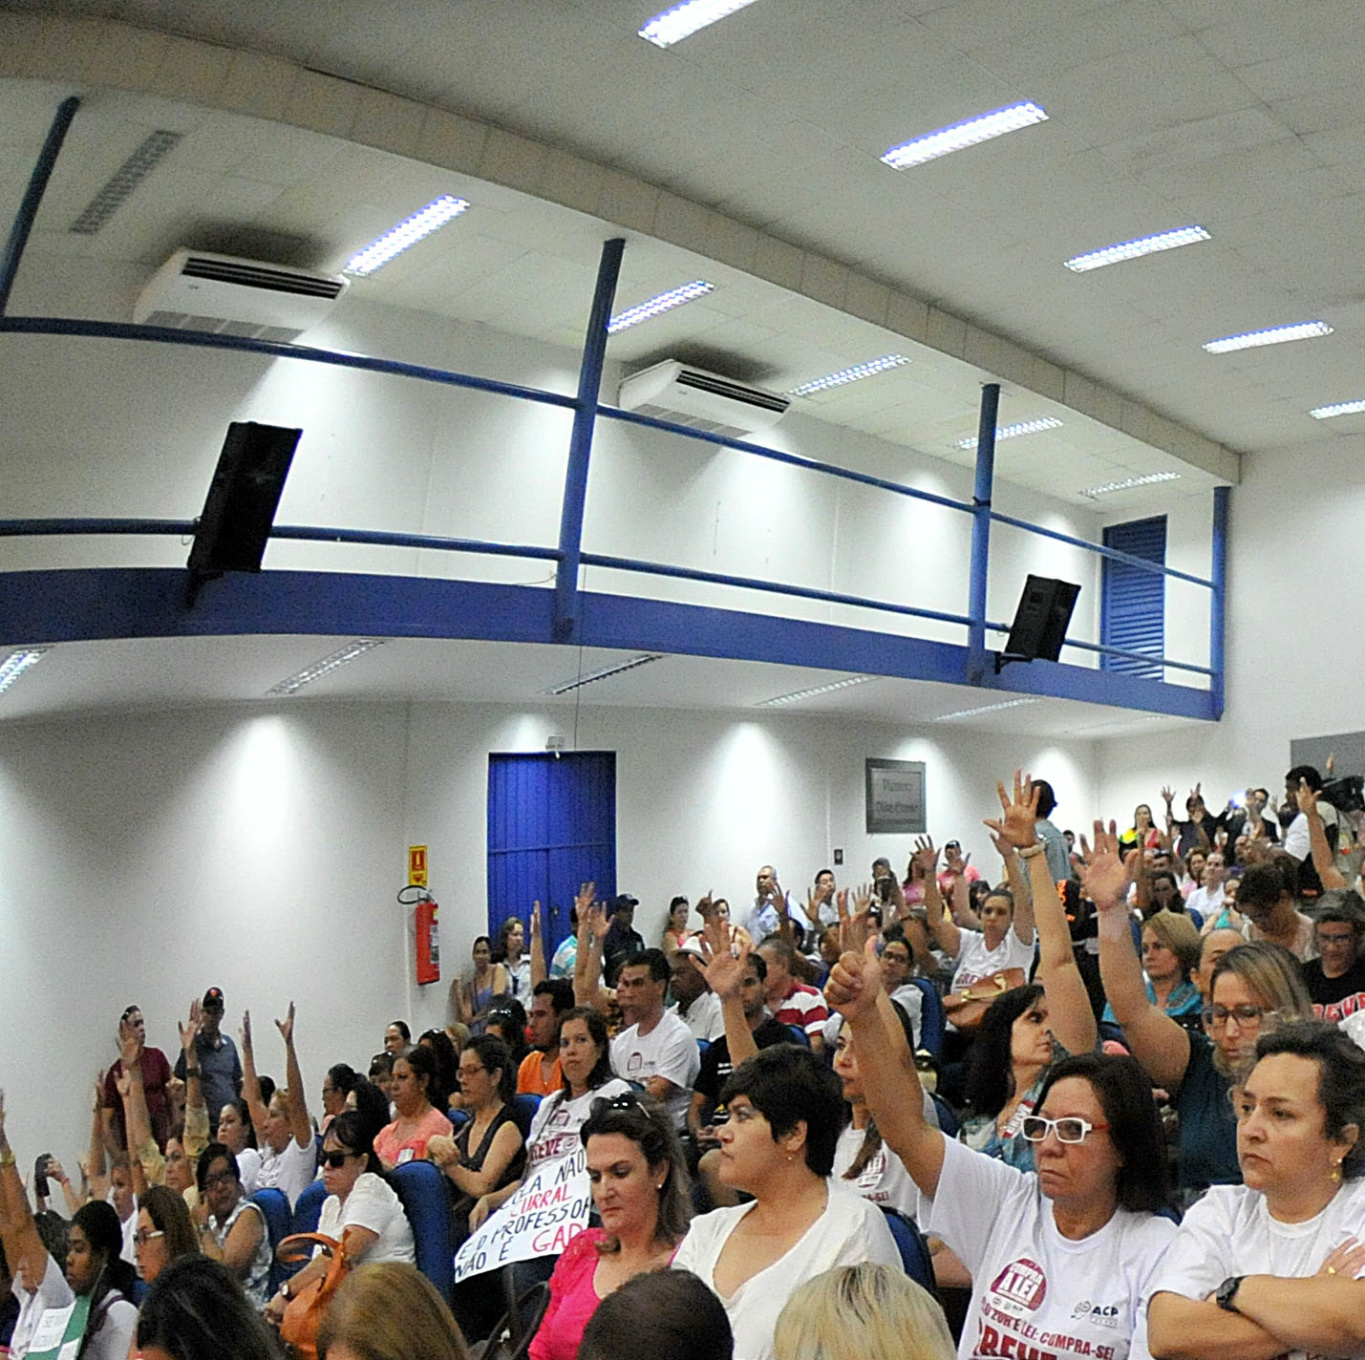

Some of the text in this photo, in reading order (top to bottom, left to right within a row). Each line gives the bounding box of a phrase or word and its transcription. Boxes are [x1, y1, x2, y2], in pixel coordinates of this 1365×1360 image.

[554, 1149, 585, 1185] NÃO
[532, 1223, 583, 1252] GAD
[1011, 1276, 1040, 1302] LEI
[1091, 1306, 1119, 1317] ACP
